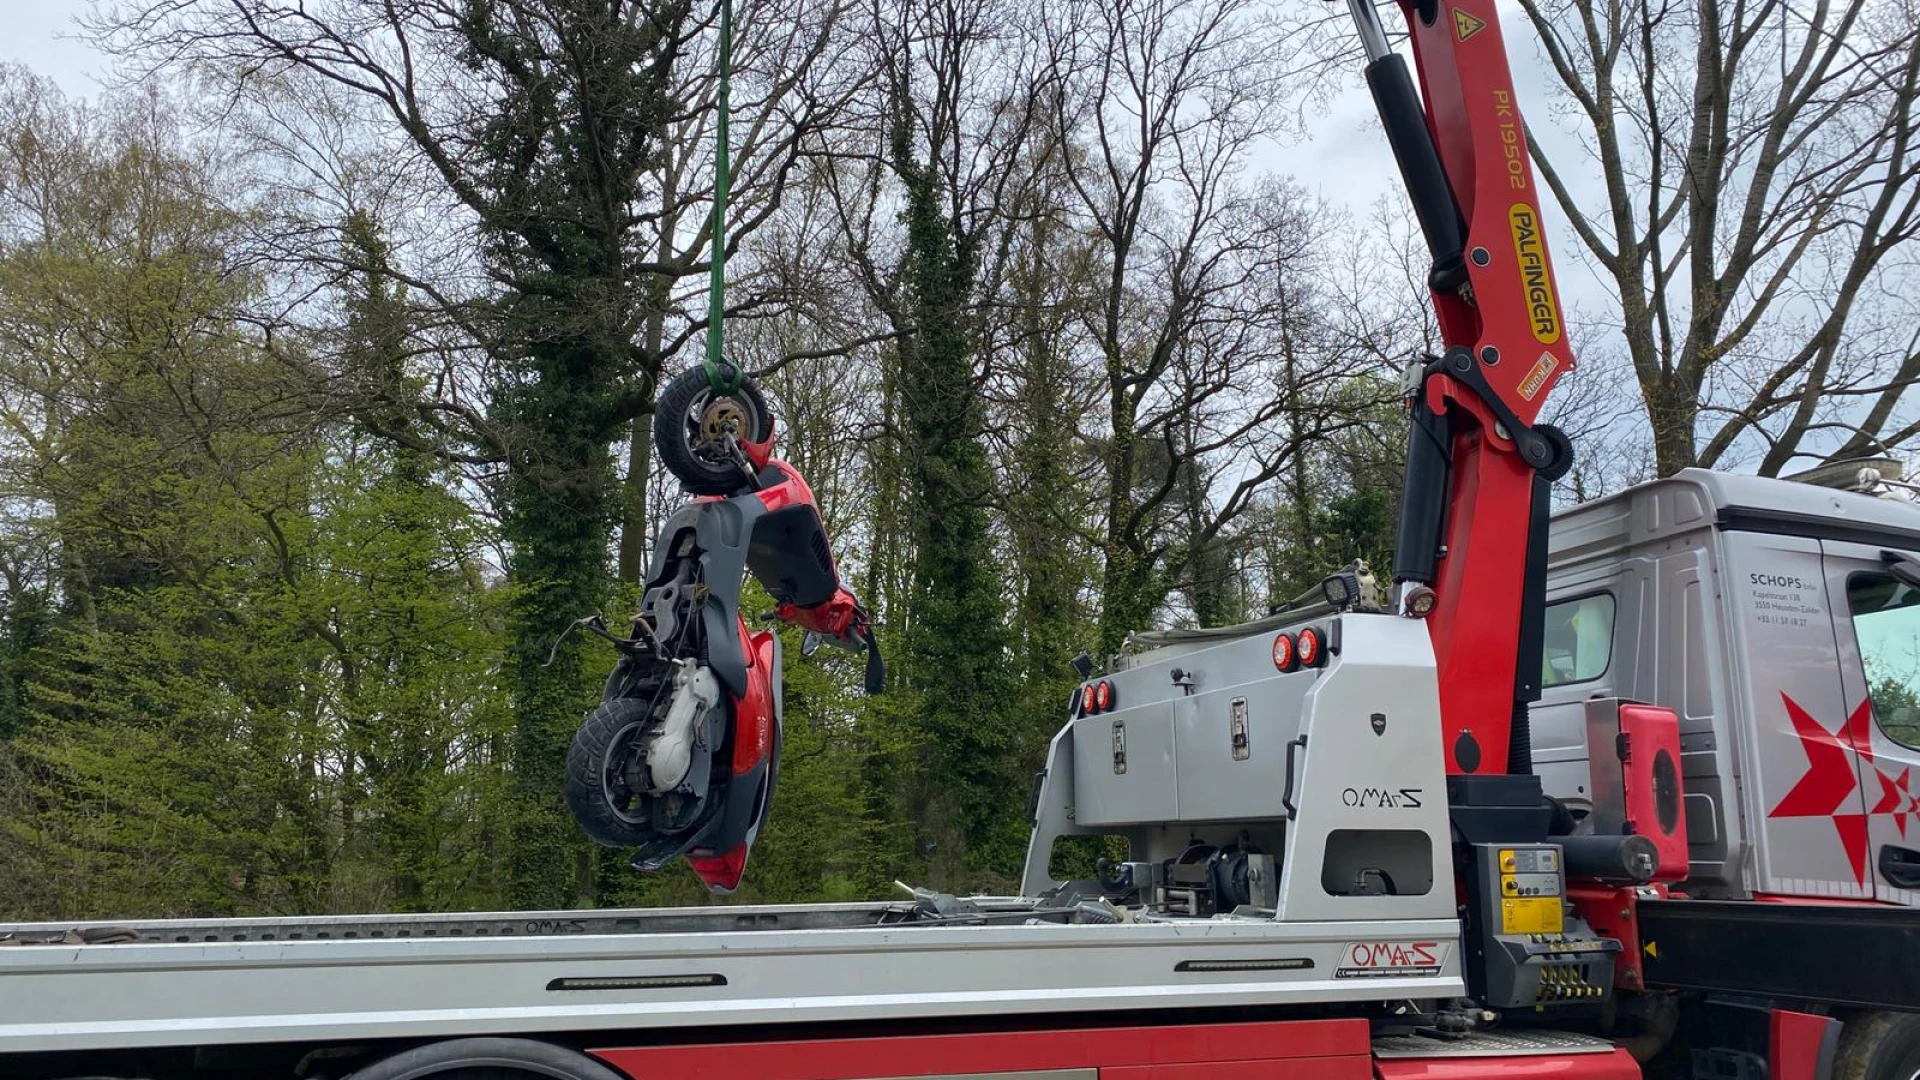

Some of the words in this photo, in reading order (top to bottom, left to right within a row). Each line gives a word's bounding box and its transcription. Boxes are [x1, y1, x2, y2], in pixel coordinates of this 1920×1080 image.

[1493, 90, 1513, 117] PK
[1499, 122, 1526, 189] 19502
[1513, 211, 1555, 335] PALFINGER
[1750, 573, 1802, 589] SCHOPS
